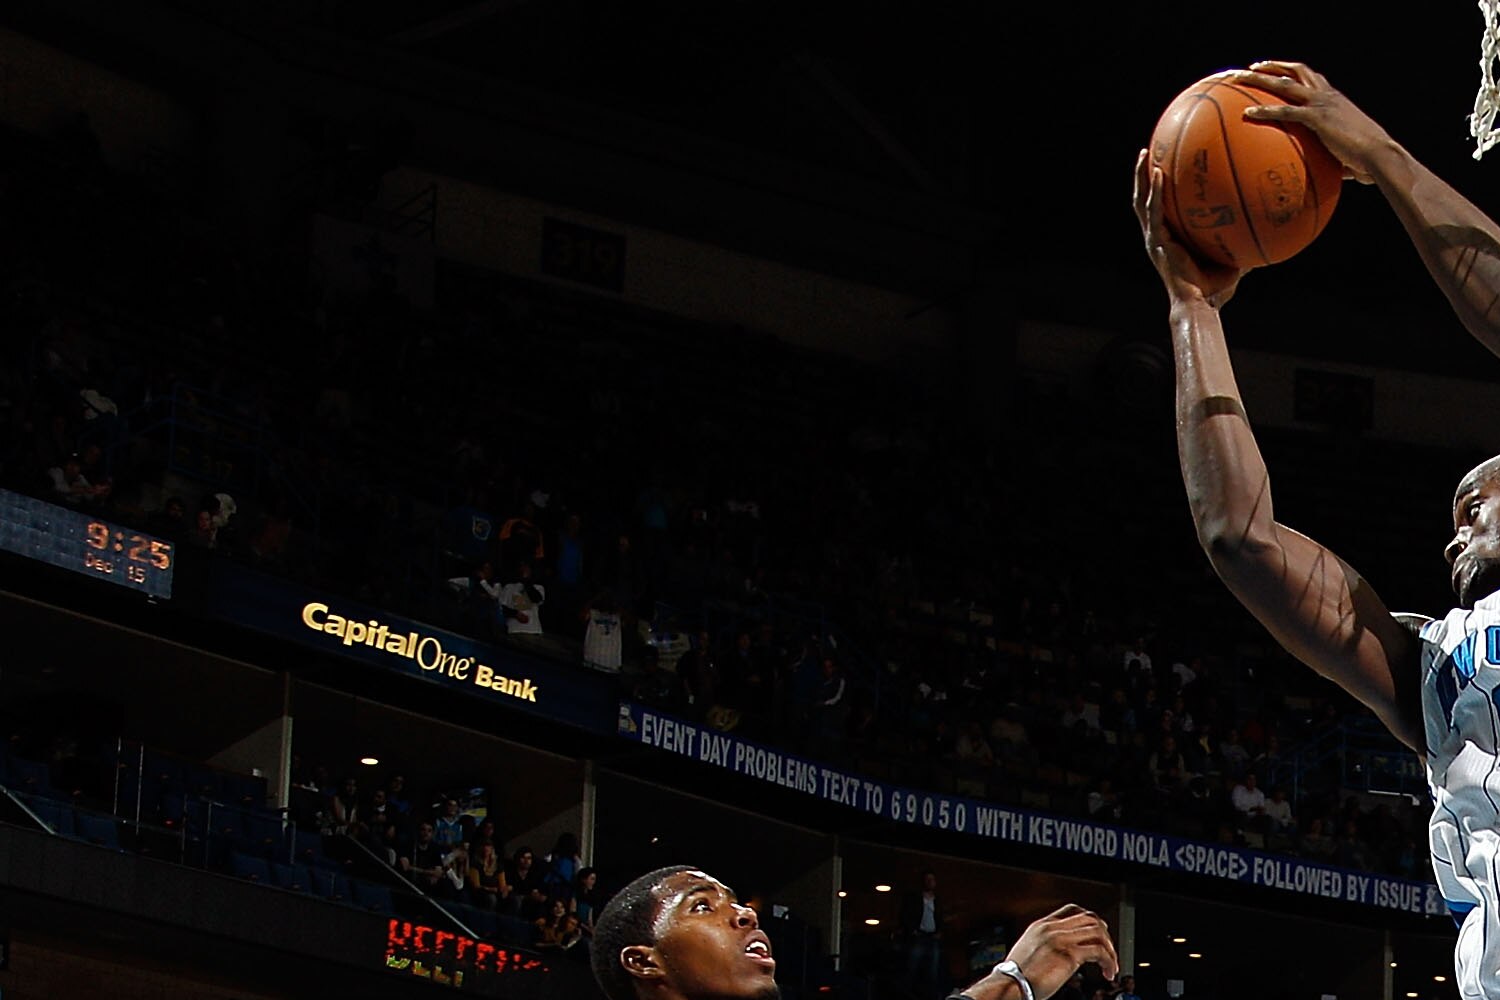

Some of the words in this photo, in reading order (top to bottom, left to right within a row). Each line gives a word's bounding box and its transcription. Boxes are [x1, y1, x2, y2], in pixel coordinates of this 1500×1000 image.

[86, 521, 171, 570] 9:25
[128, 565, 146, 583] 15
[475, 665, 538, 702] Bank
[642, 713, 696, 756] EVENT
[700, 731, 731, 767] DAY
[735, 743, 817, 794] PROBLEMS
[821, 769, 860, 807] TEXT
[864, 782, 883, 814] TO
[976, 807, 1023, 841] WITH
[1029, 816, 1117, 857] KEYWORD
[1123, 832, 1170, 867] NOLA
[1175, 843, 1248, 879] <SPACE>
[1253, 857, 1344, 898] FOLLOWED
[1347, 877, 1369, 903] BY
[1373, 879, 1420, 913] ISSUE
[1425, 885, 1437, 913] &
